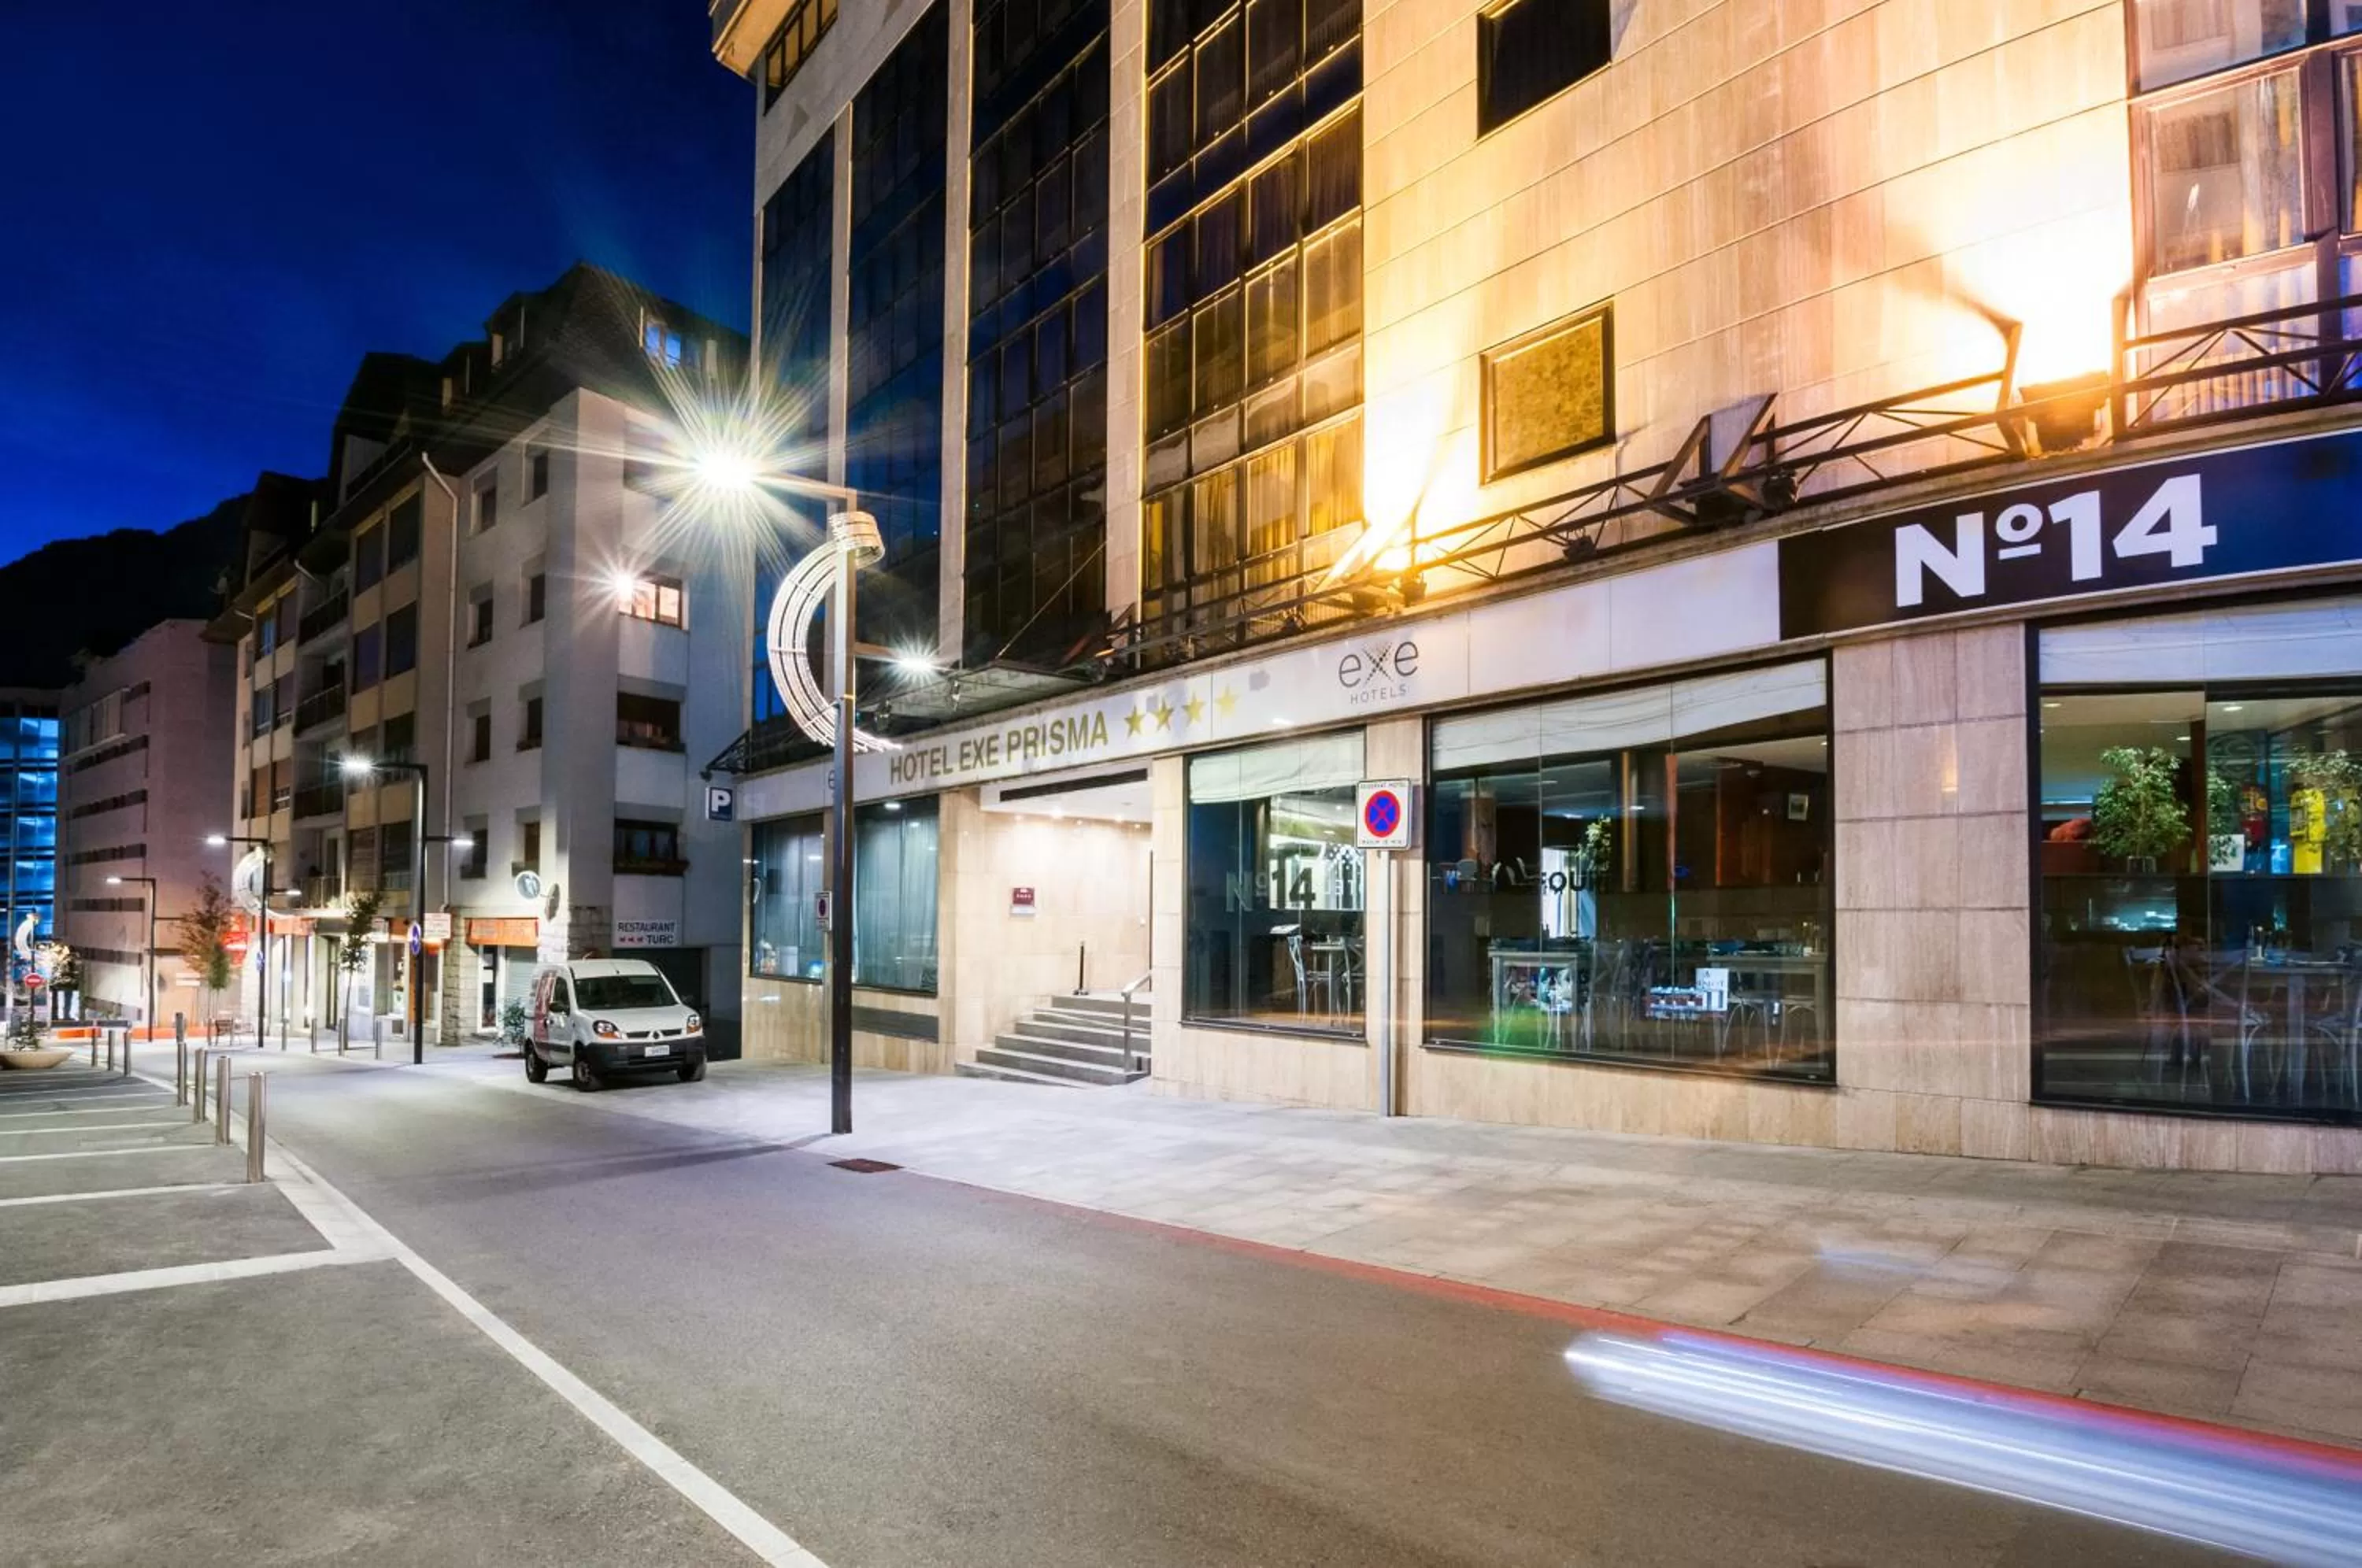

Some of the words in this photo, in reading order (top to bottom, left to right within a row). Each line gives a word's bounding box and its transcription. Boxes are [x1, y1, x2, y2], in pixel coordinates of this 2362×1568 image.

[1350, 683, 1406, 704] HOTELS
[890, 745, 953, 785] HOTEL
[960, 734, 1000, 771] EXE
[1006, 711, 1109, 763] PRISMA
[711, 790, 731, 812] P
[617, 922, 676, 933] RESTAURANT
